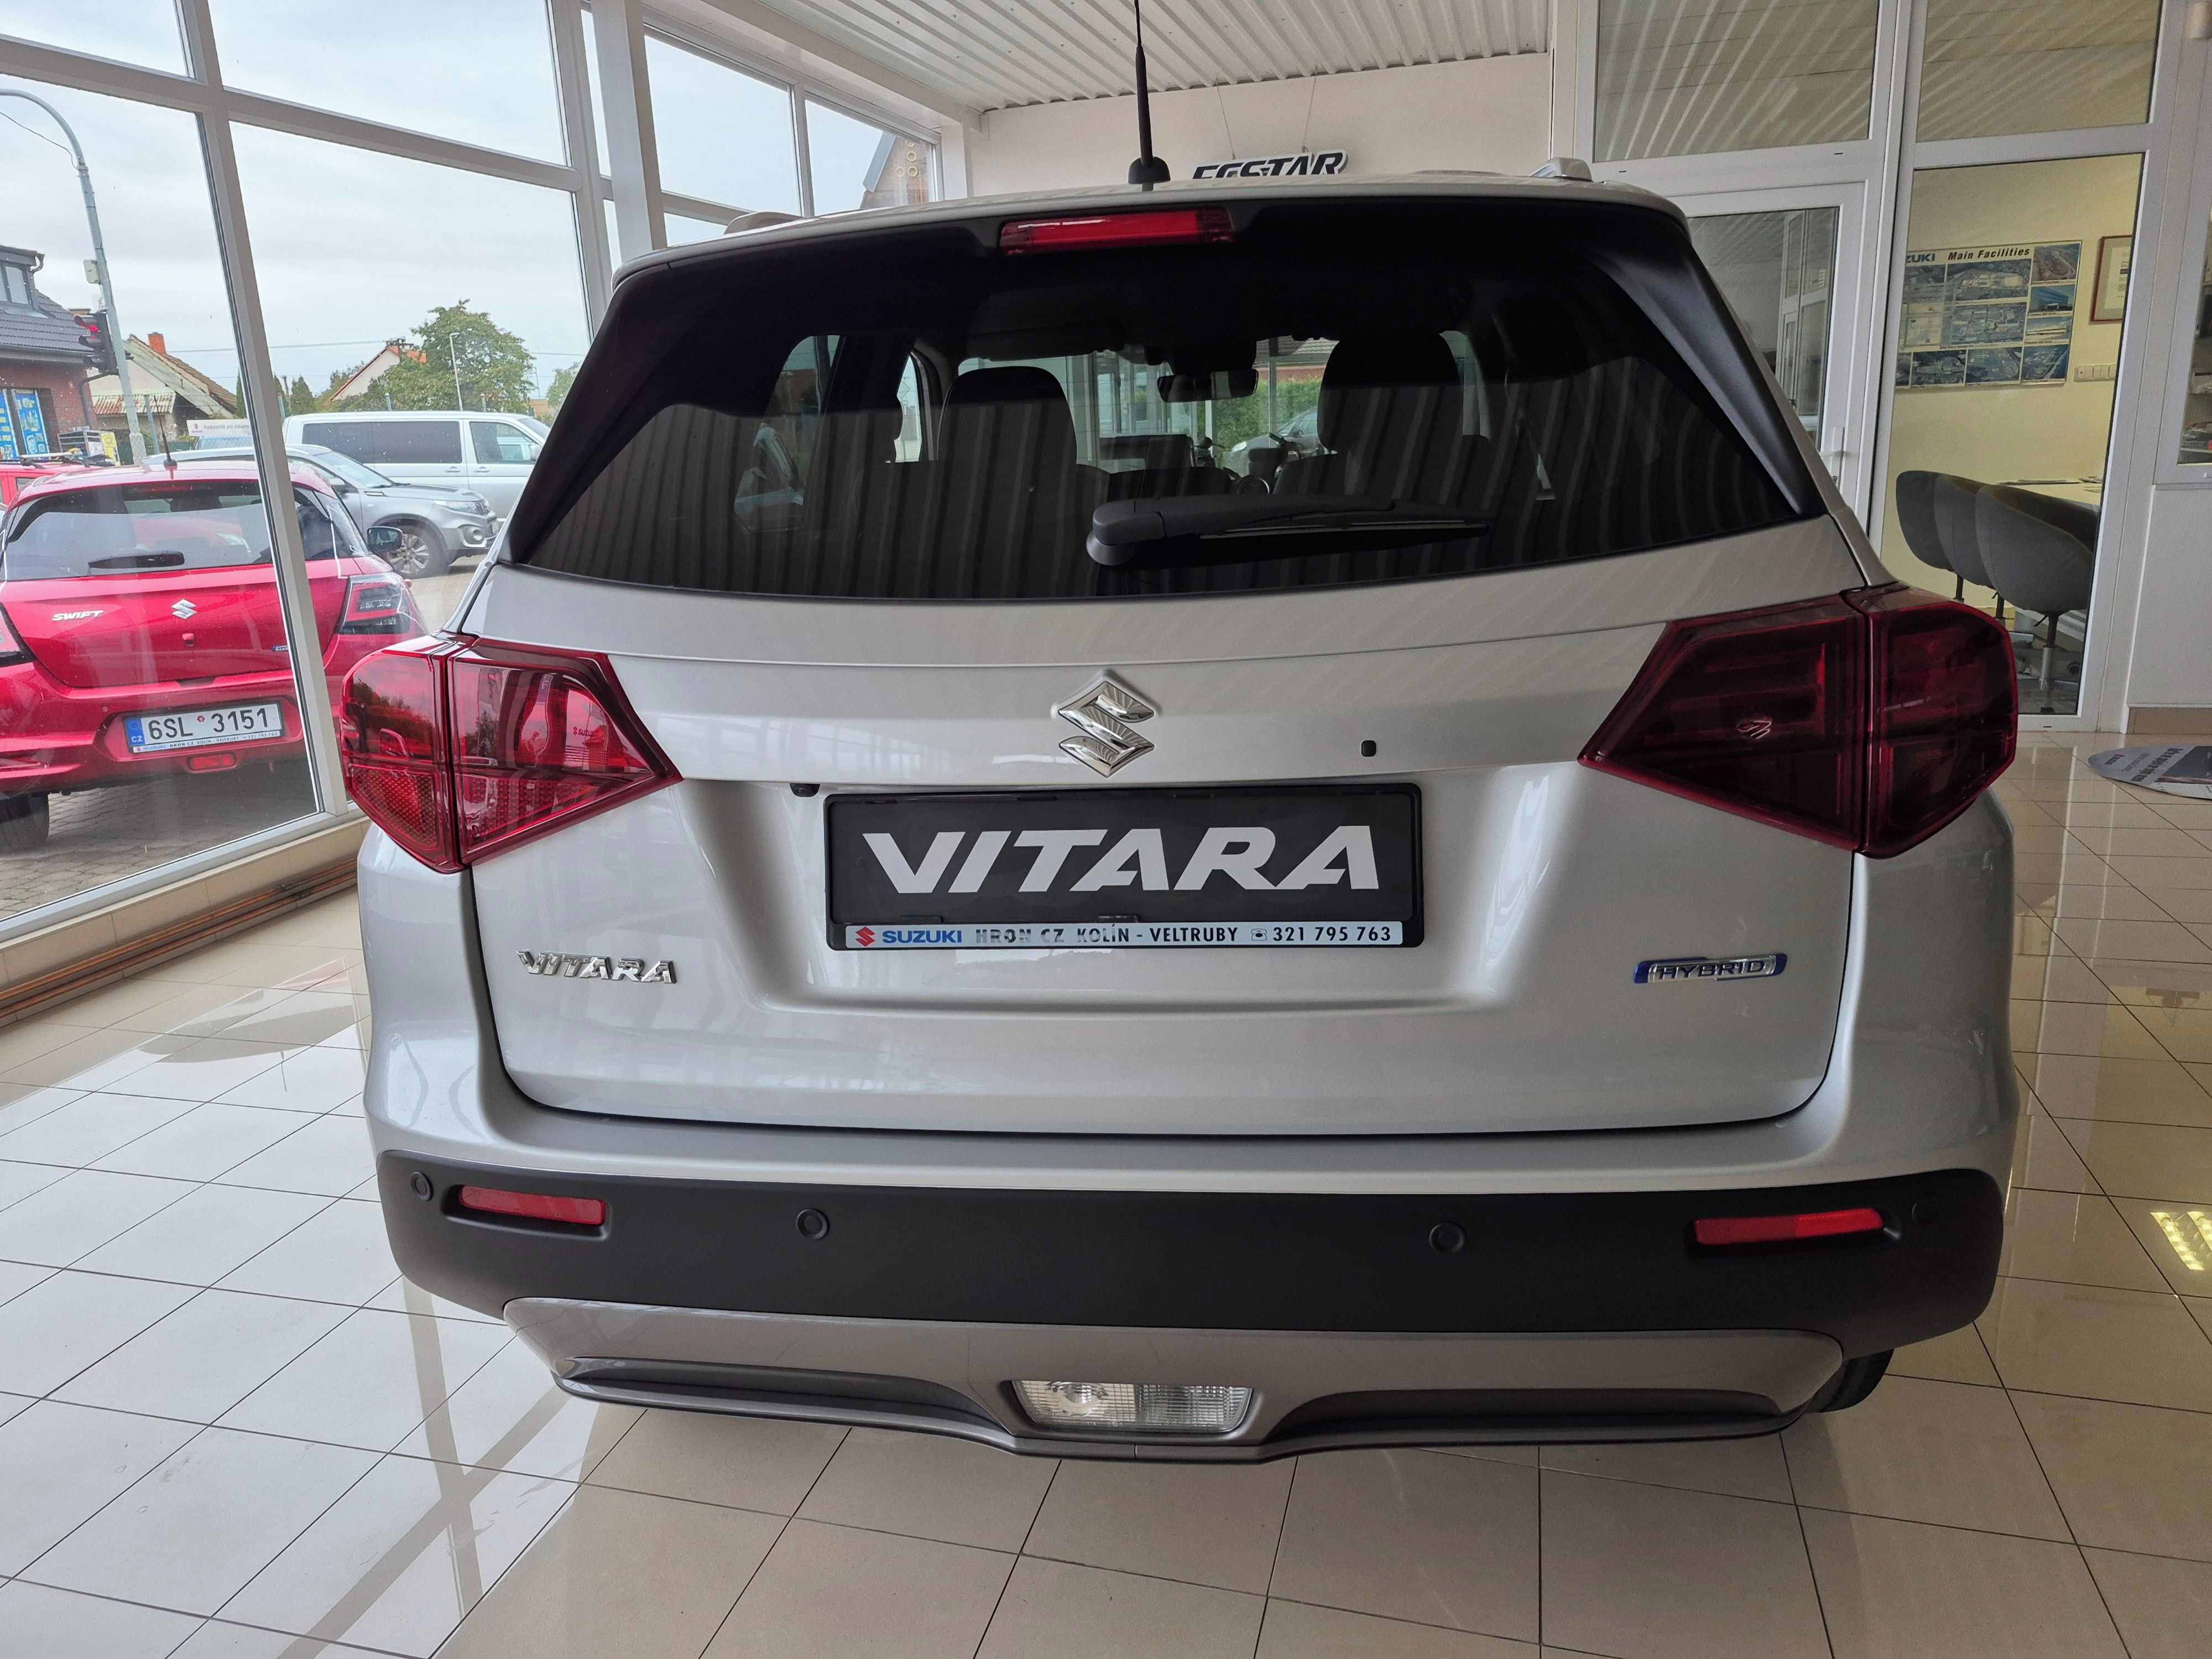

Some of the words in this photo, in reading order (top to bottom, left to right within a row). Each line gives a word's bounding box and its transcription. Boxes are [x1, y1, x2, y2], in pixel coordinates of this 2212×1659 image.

[1906, 253, 1936, 263] ZUKI
[1947, 249, 1974, 261] Main
[1977, 247, 2031, 259] Facilities
[51, 609, 105, 622] SWIFT
[148, 717, 193, 740] 6SL
[211, 708, 268, 733] 3151
[862, 825, 1380, 894] VITARA
[881, 930, 962, 943] SUZUKI
[975, 928, 1032, 943] HRON
[1040, 928, 1065, 943] CZ
[1077, 924, 1129, 943] KOLÍN
[1149, 927, 1238, 942] VELTRUBY
[1272, 926, 1305, 942] 321
[1314, 926, 1348, 942] 795
[1356, 926, 1391, 942] 763
[516, 949, 677, 984] VITARA
[1658, 959, 1768, 980] HYBRID
